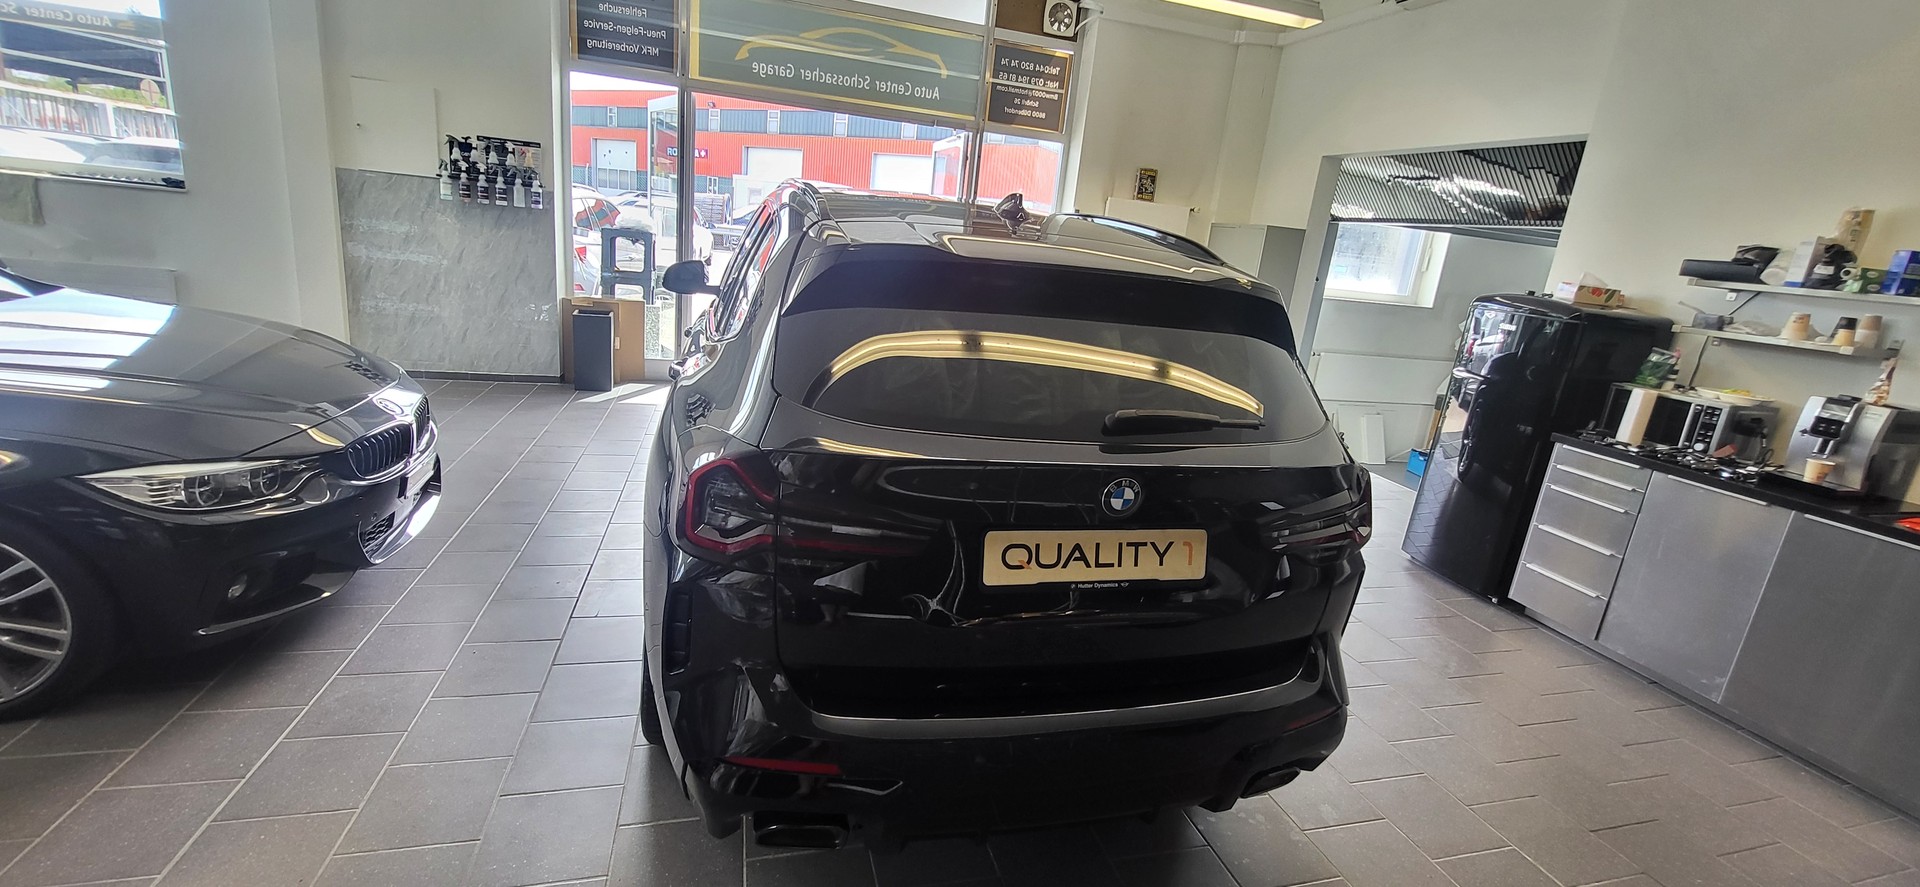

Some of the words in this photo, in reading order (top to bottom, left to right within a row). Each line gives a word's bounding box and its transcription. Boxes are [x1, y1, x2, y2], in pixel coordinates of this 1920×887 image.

[1109, 480, 1140, 493] BMW
[1001, 541, 1175, 571] QUALITY
[1182, 541, 1194, 566] 1
